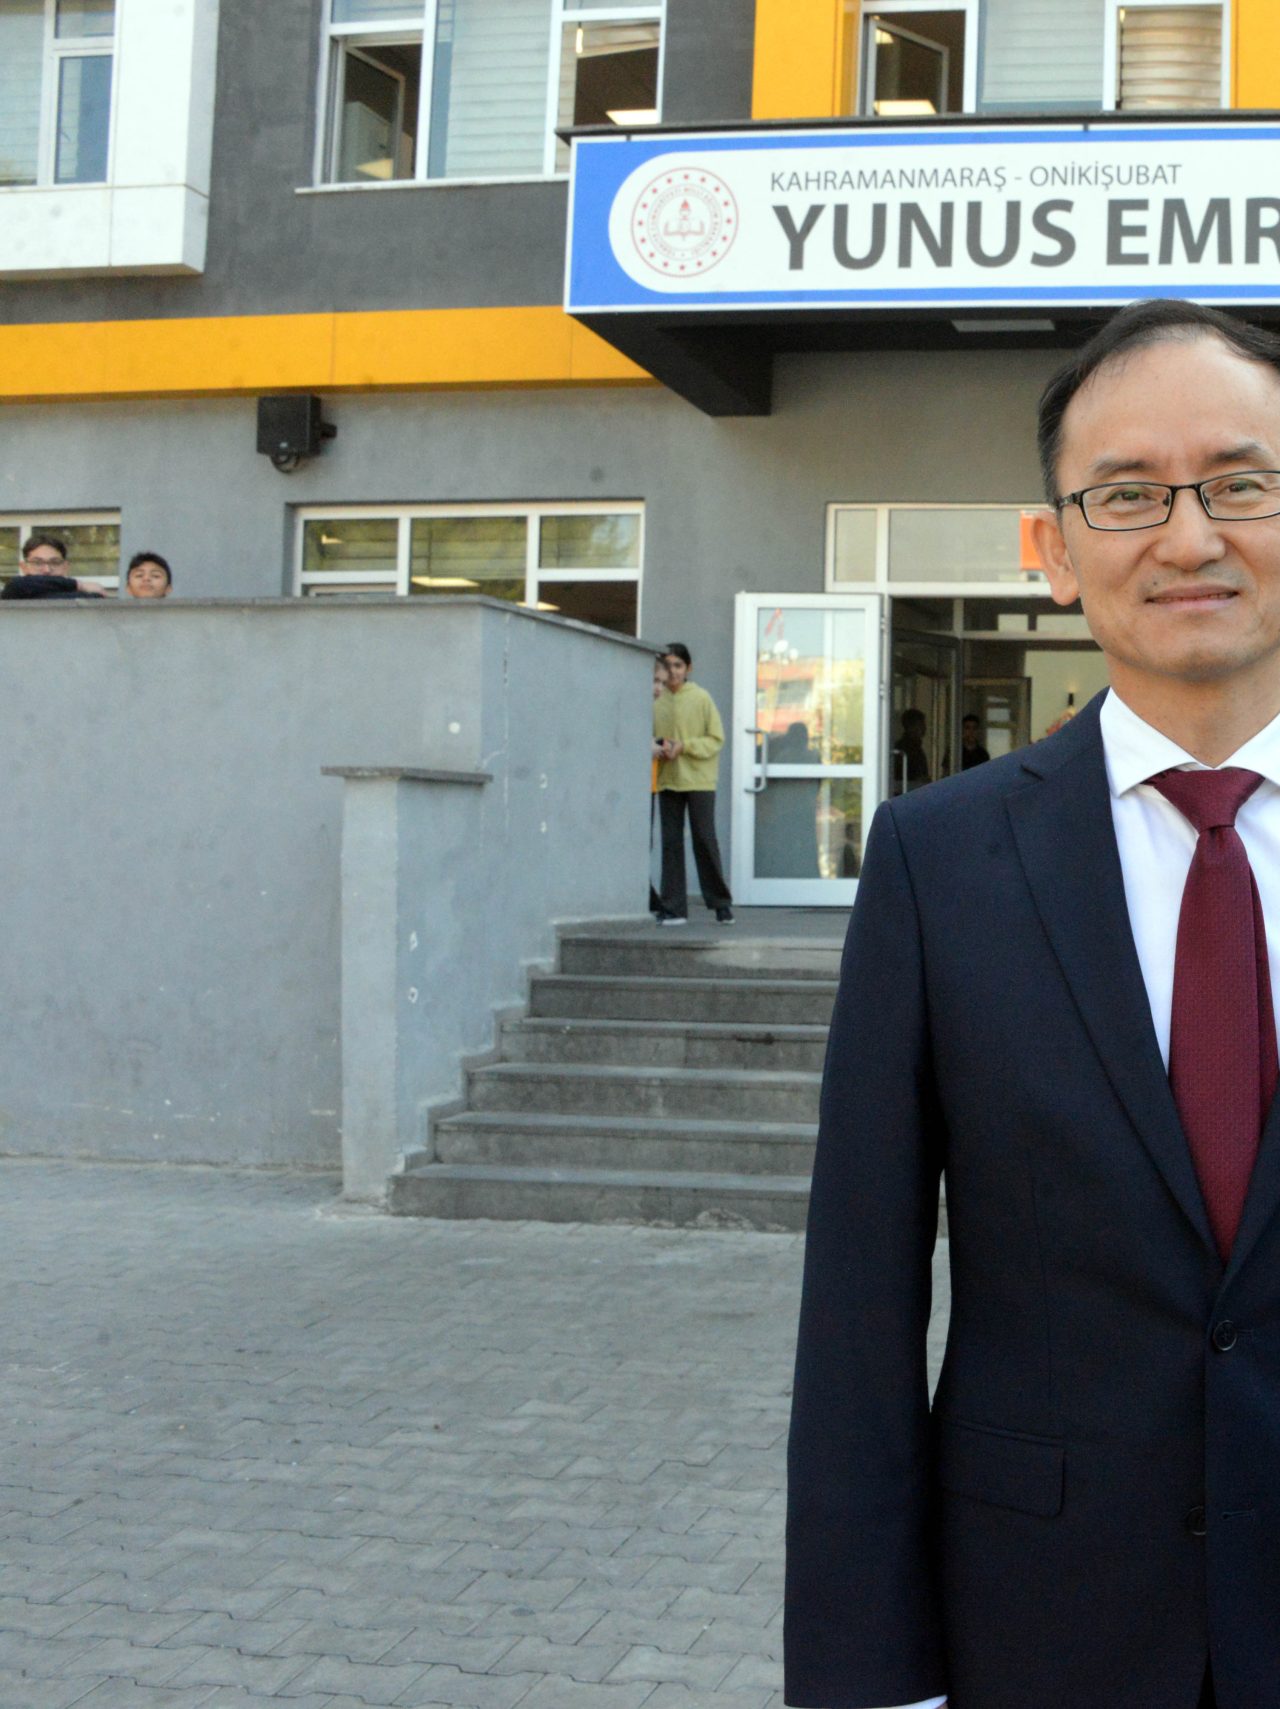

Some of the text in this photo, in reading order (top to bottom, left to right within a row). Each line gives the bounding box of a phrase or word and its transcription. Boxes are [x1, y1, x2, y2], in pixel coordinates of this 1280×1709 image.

[770, 166, 1007, 193] KAHRAMANMARAŞ
[1029, 161, 1183, 192] ONİKİŞUBAT
[771, 199, 1077, 271] YUNUS
